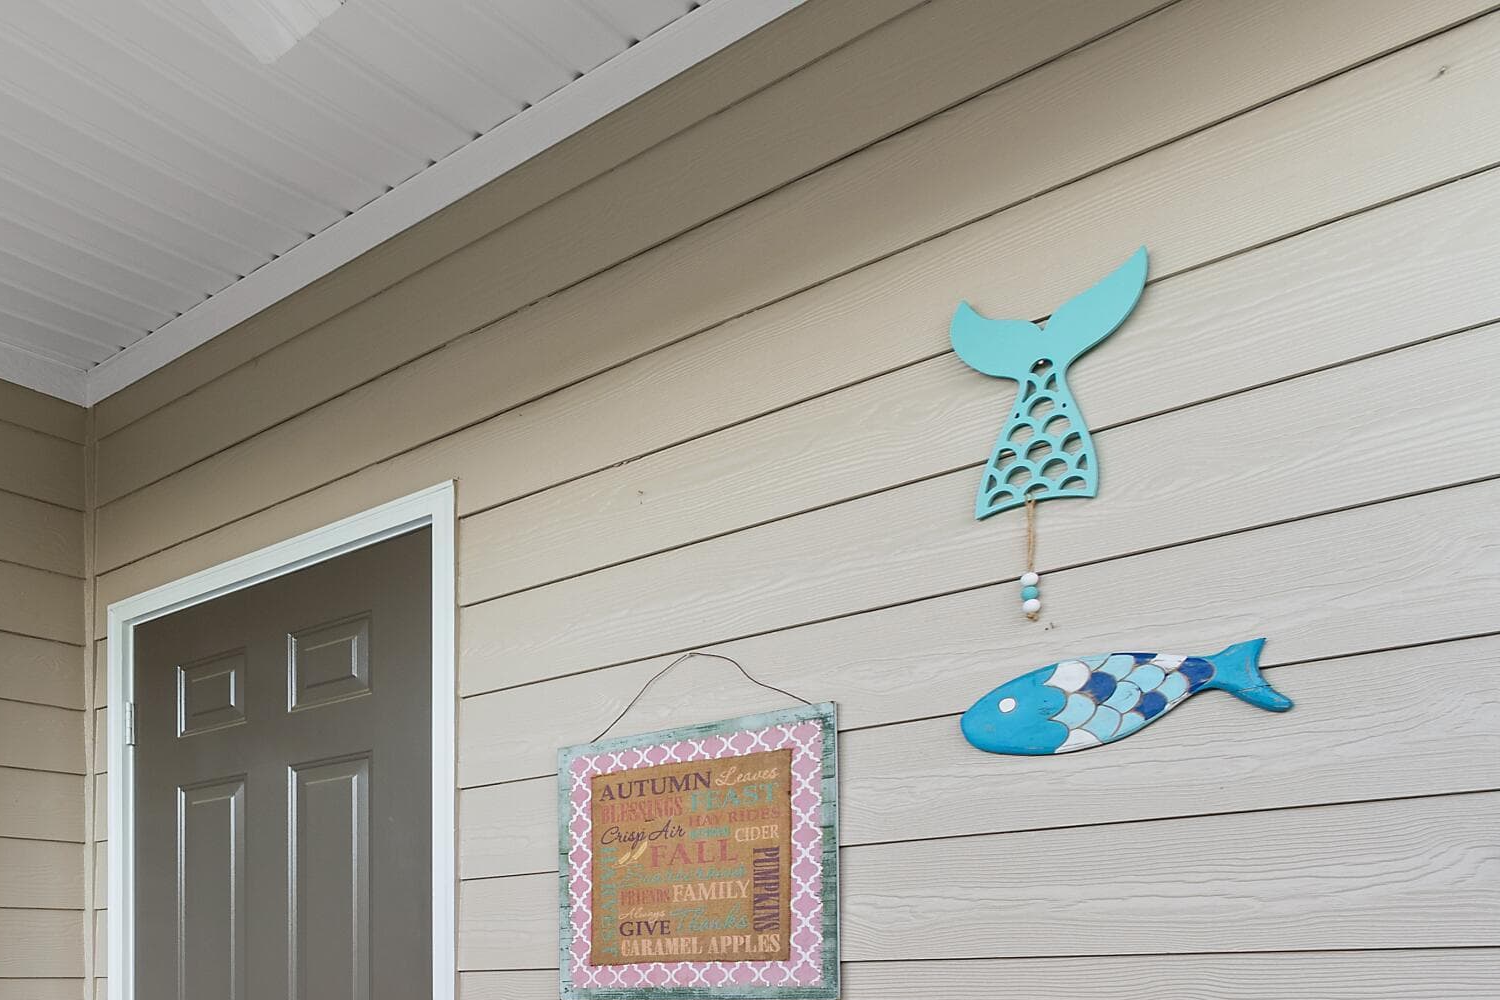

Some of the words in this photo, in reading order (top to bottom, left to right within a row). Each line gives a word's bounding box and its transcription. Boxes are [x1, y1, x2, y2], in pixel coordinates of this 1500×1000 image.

[600, 771, 711, 801] AUTUMN
[715, 766, 780, 786] Leaves
[690, 783, 778, 812] FEAST
[601, 826, 647, 850] Crisp
[648, 818, 686, 840] Air
[735, 824, 780, 842] CIDER
[650, 840, 739, 868] FALL
[672, 880, 750, 903] FAMILY
[753, 846, 780, 932] PUMPKINS
[619, 920, 671, 937] GIVE
[669, 902, 749, 933] Thanks
[621, 936, 703, 957] CARAMEL
[706, 933, 781, 955] APPLES
